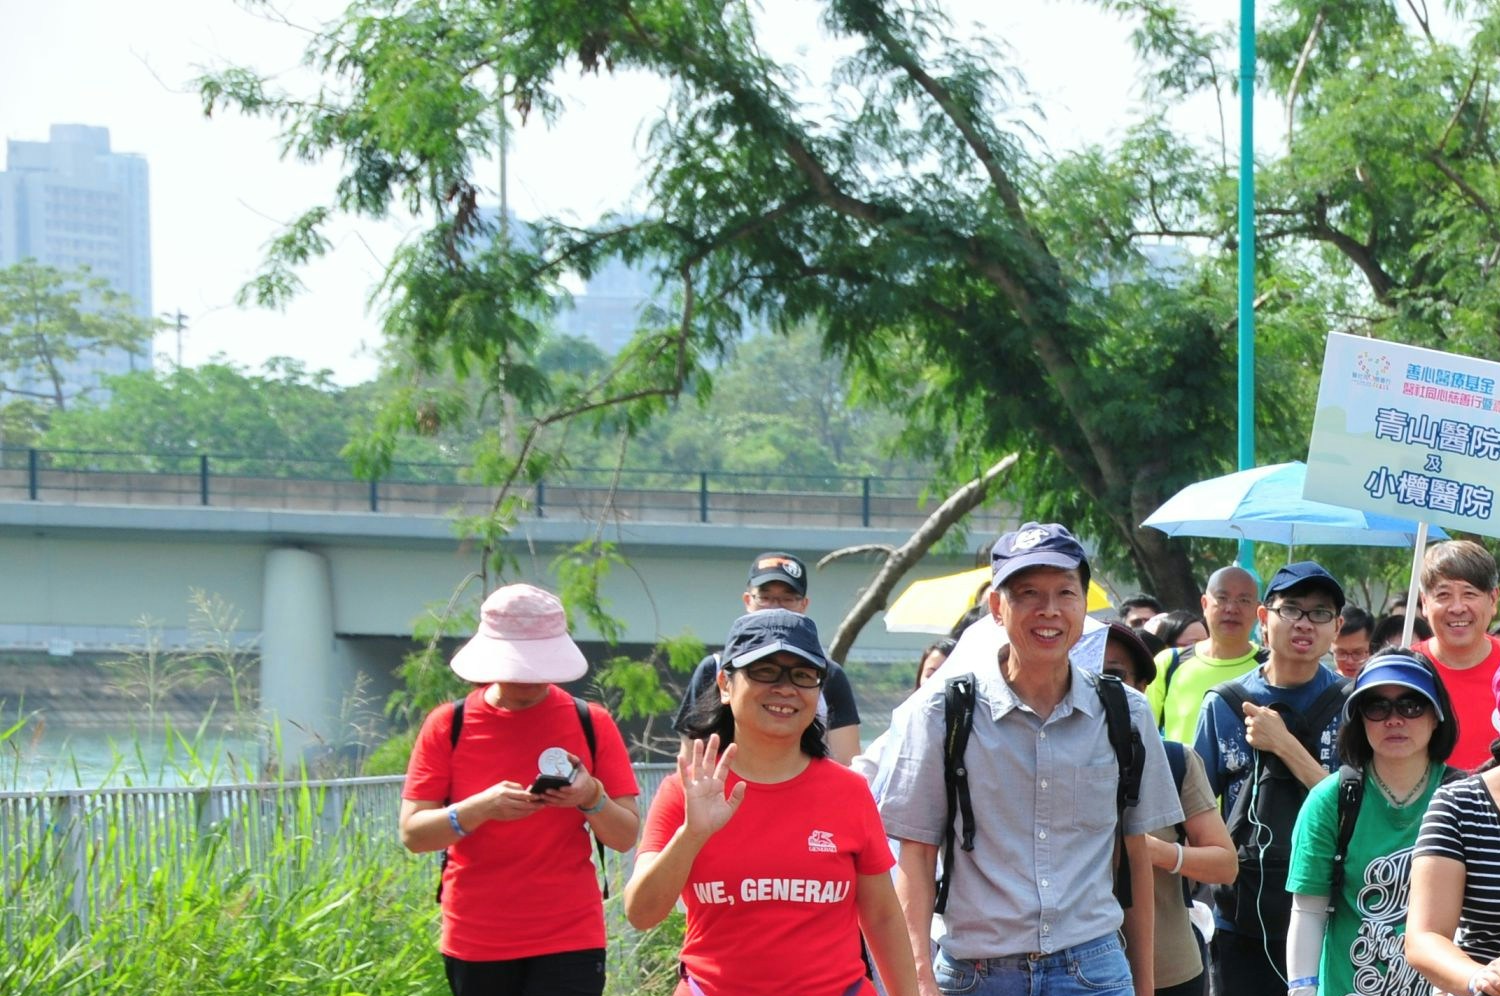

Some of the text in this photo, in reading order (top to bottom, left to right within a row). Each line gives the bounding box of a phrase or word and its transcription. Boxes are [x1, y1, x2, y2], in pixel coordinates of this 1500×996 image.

[1405, 363, 1496, 395] 善心醫療基金
[1424, 454, 1443, 472] 及
[1364, 465, 1494, 519] 小欖醫院
[693, 881, 735, 906] WE,
